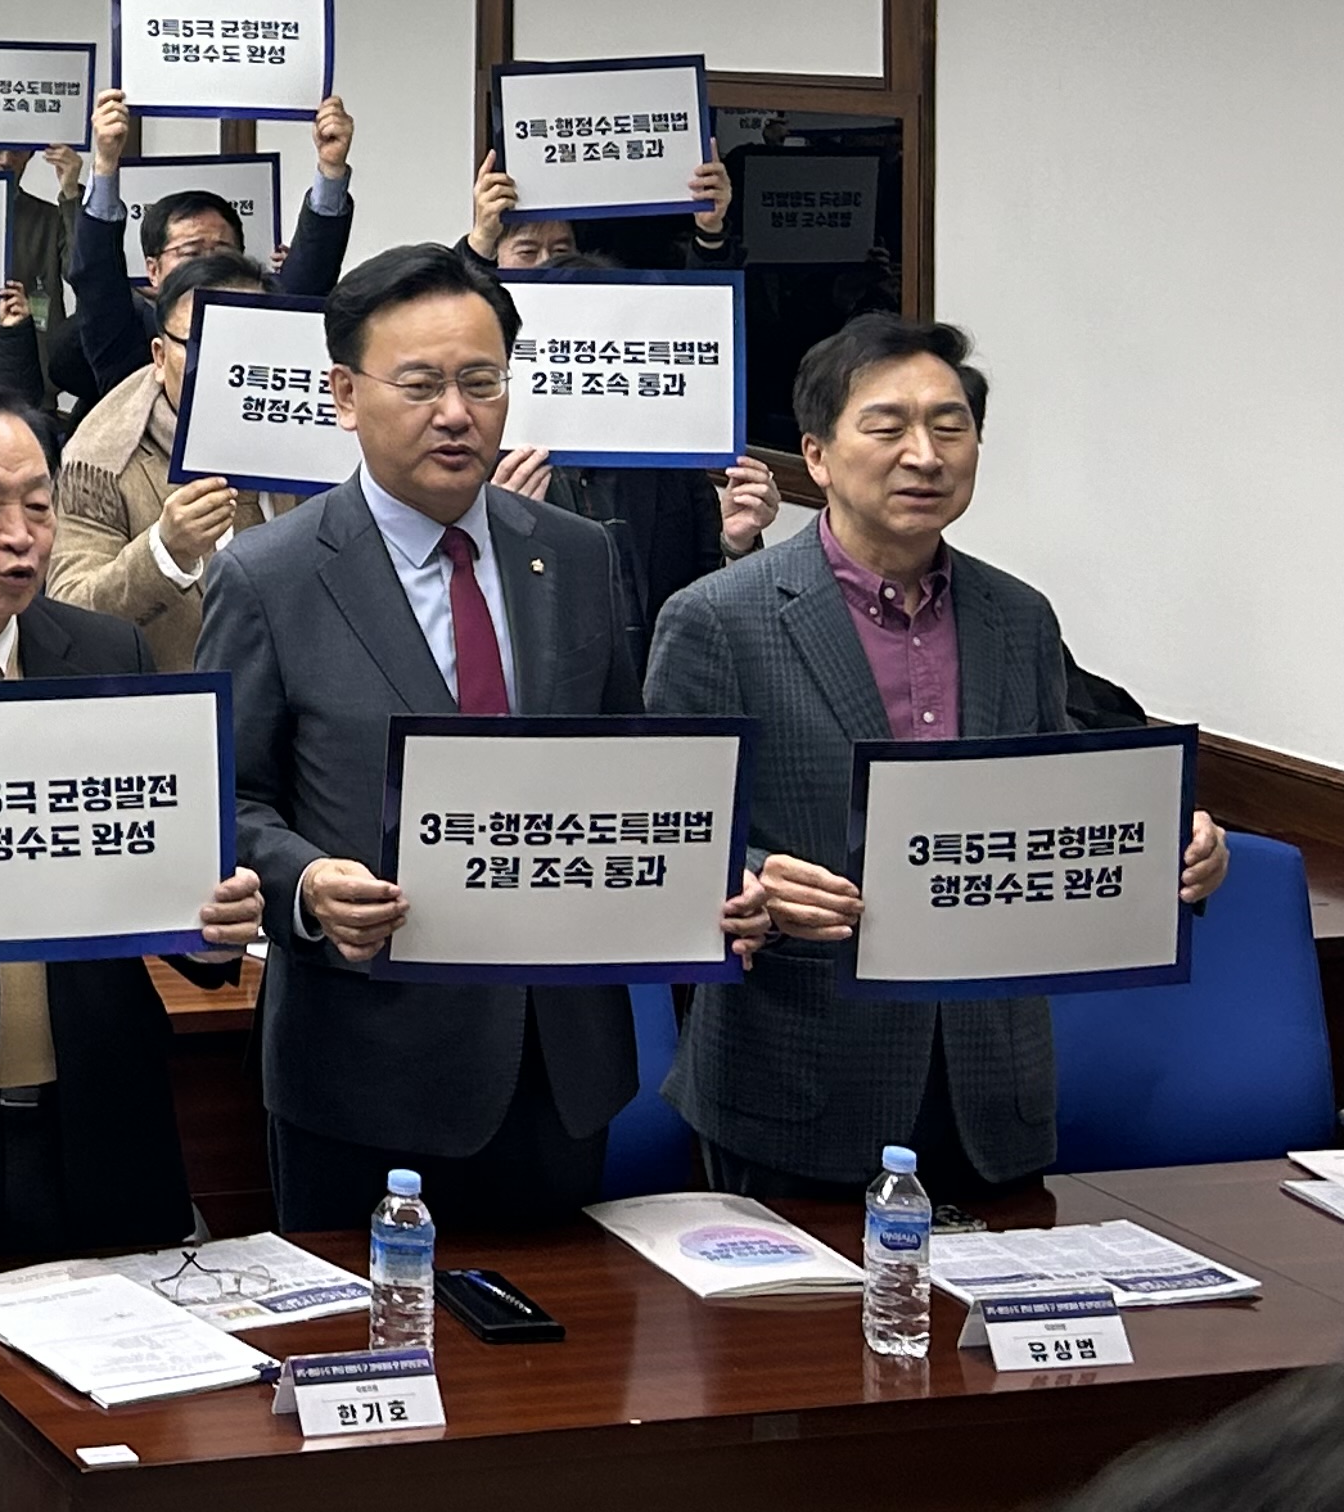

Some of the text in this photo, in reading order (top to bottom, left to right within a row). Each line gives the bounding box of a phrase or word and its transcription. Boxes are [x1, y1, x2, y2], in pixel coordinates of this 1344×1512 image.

[148, 19, 299, 40] 3특5극 균형발전
[162, 43, 285, 64] 행정수도 완성
[3, 99, 29, 112] 조속
[35, 99, 61, 113] 통과
[516, 112, 688, 139] 3특·행정수도특별법
[545, 139, 664, 163] 2월 조속 통과
[229, 365, 311, 393] 3특5극
[532, 372, 686, 397] 2월 조속 통과
[242, 396, 339, 426] 행정수도
[48, 774, 178, 813] 균형발전
[92, 820, 155, 856] 완성
[420, 811, 713, 846] 3특·행정수도특별법
[909, 822, 1144, 866] 3특5극 균형발전
[466, 855, 667, 888] 2월 조속 통과
[931, 865, 1122, 907] 행정수도 완성
[1028, 1338, 1097, 1363] 유상범
[337, 1399, 409, 1426] 한기호
